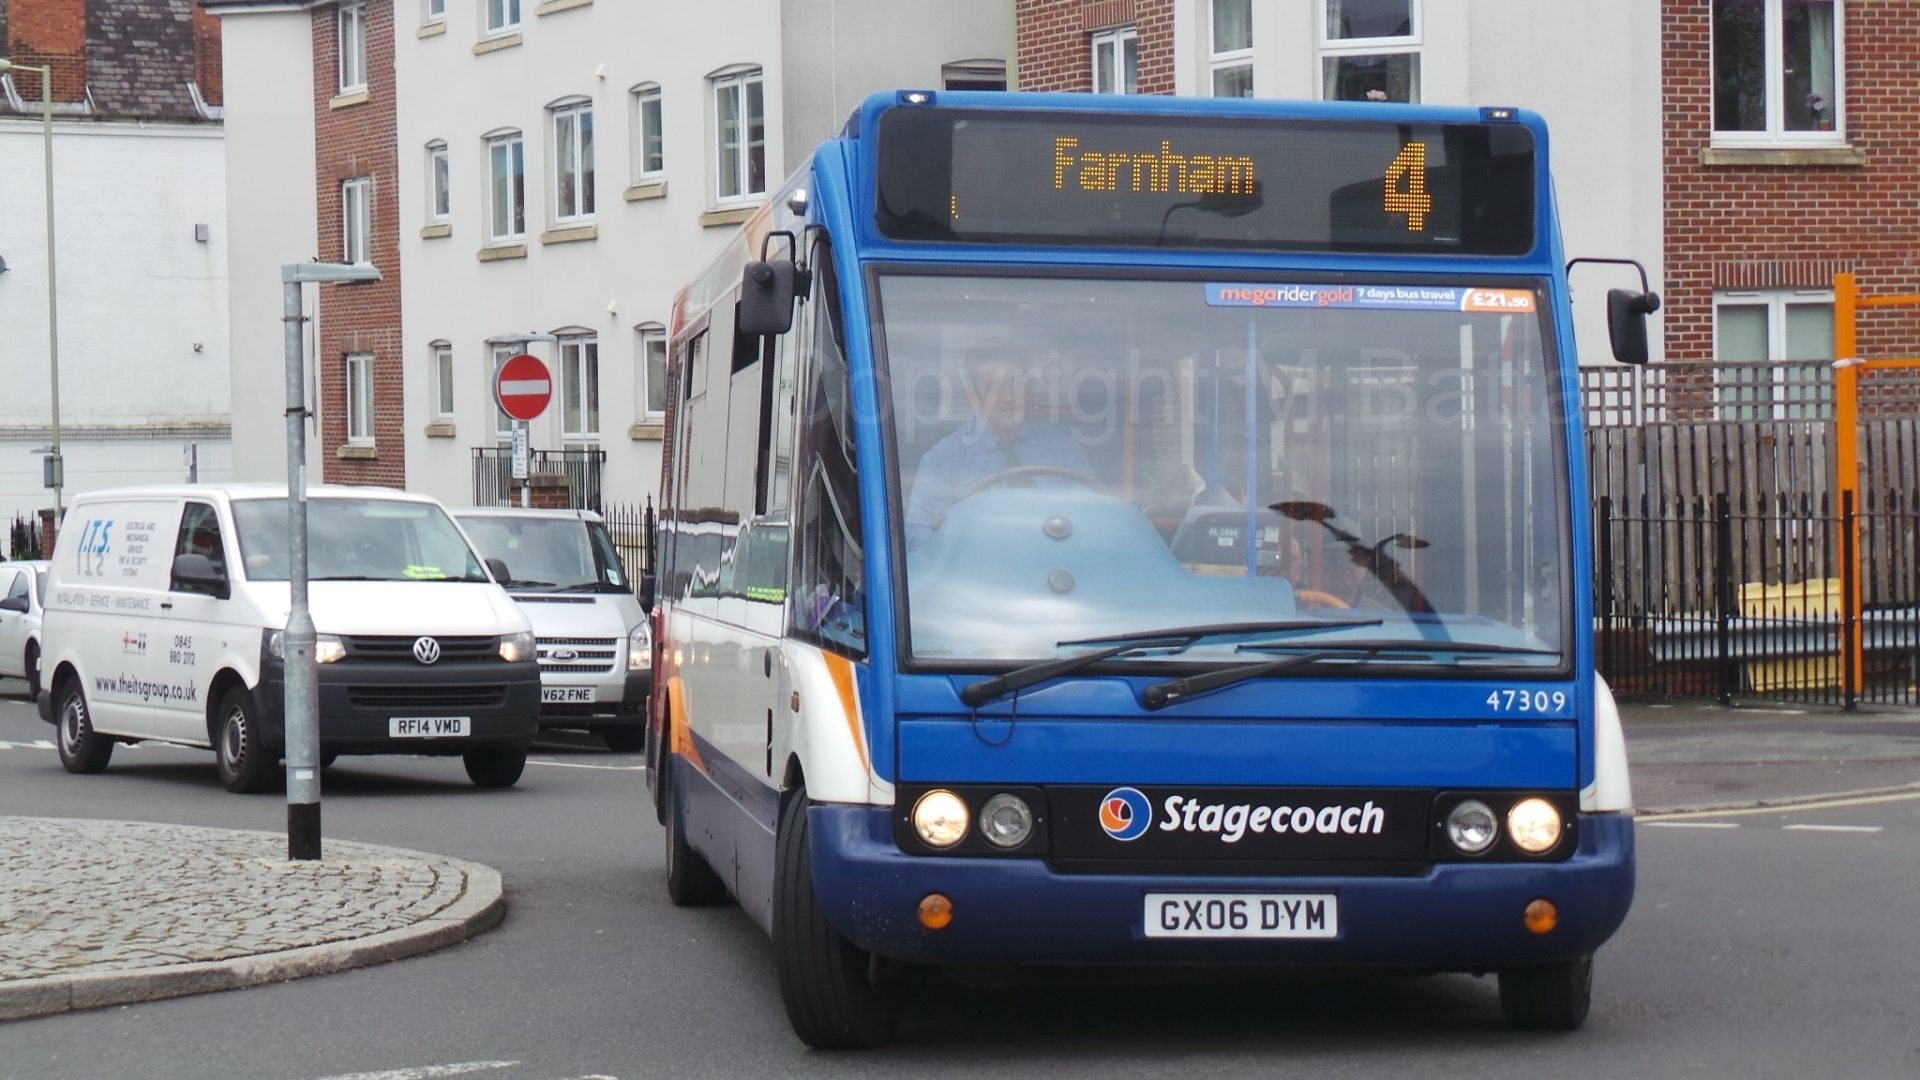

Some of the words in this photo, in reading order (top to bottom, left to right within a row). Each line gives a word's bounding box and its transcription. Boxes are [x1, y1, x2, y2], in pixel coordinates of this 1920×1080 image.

[1055, 138, 1254, 194] Farnham
[1384, 142, 1431, 231] 4
[1357, 288, 1366, 298] 7
[1367, 288, 1396, 300] days
[1397, 289, 1419, 299] bus
[1420, 289, 1456, 300] travel
[174, 635, 192, 649] 0845
[169, 650, 181, 664] 880
[95, 672, 197, 702] www.theitsgroup.co.uk
[568, 689, 591, 701] FNE
[1486, 690, 1566, 712] 47309
[398, 719, 430, 734] RF14
[435, 719, 461, 733] VMD
[1159, 795, 1385, 843] Stagecoach
[1160, 900, 1249, 930] GX06
[1260, 900, 1325, 930] DYM
